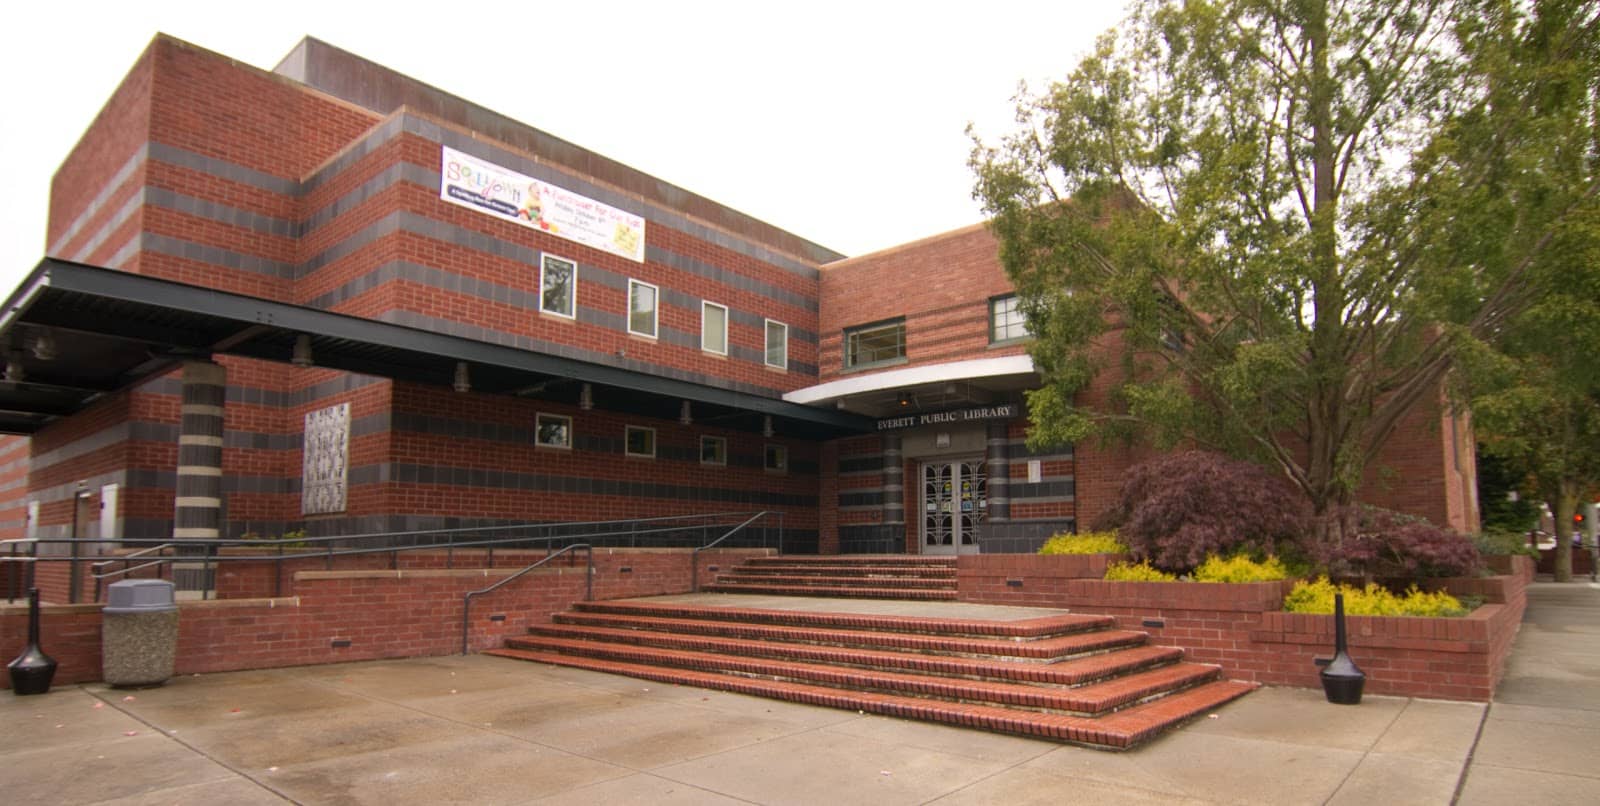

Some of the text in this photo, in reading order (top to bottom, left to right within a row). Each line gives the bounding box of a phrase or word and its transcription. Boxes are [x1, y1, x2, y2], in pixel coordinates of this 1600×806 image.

[878, 407, 1011, 430] EVERETT PUBLIC LIBRARY
